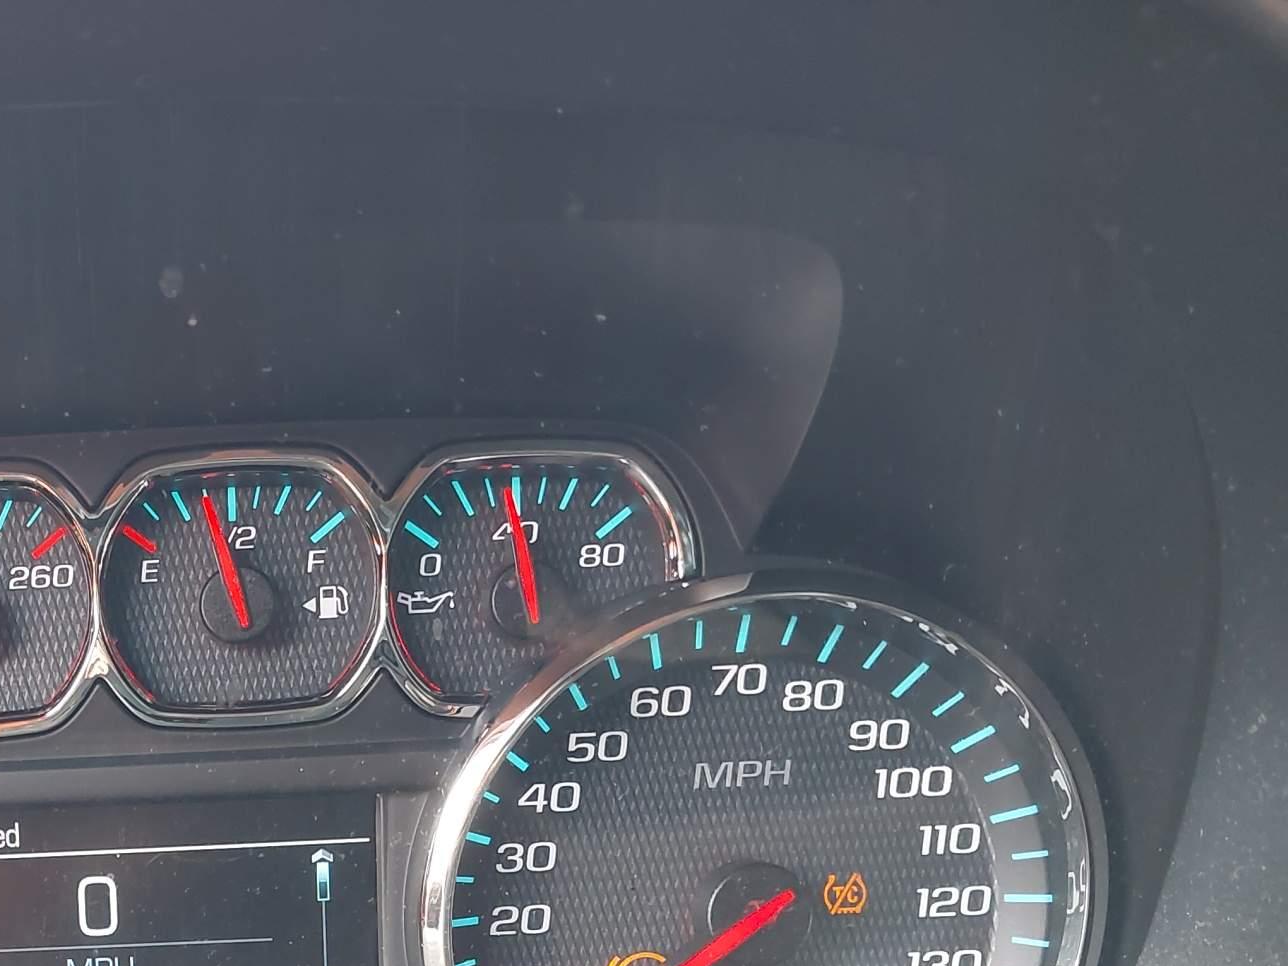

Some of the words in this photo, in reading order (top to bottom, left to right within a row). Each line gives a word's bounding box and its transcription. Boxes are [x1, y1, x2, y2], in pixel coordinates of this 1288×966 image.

[220, 526, 256, 549] /2
[307, 550, 326, 572] F
[420, 554, 441, 576] 0
[579, 544, 624, 567] 80
[10, 564, 74, 589] 260
[141, 560, 159, 583] E
[712, 664, 767, 695] 70
[630, 686, 692, 717] 60
[782, 679, 844, 712] 80
[567, 731, 629, 762] 50
[848, 719, 909, 751] 90
[693, 758, 791, 789] MPH
[875, 766, 952, 798] 100
[518, 781, 580, 812] 40
[919, 824, 981, 855] 110
[496, 842, 557, 873] 30
[77, 876, 118, 937] 0
[917, 886, 991, 917] 120
[490, 904, 551, 935] 20
